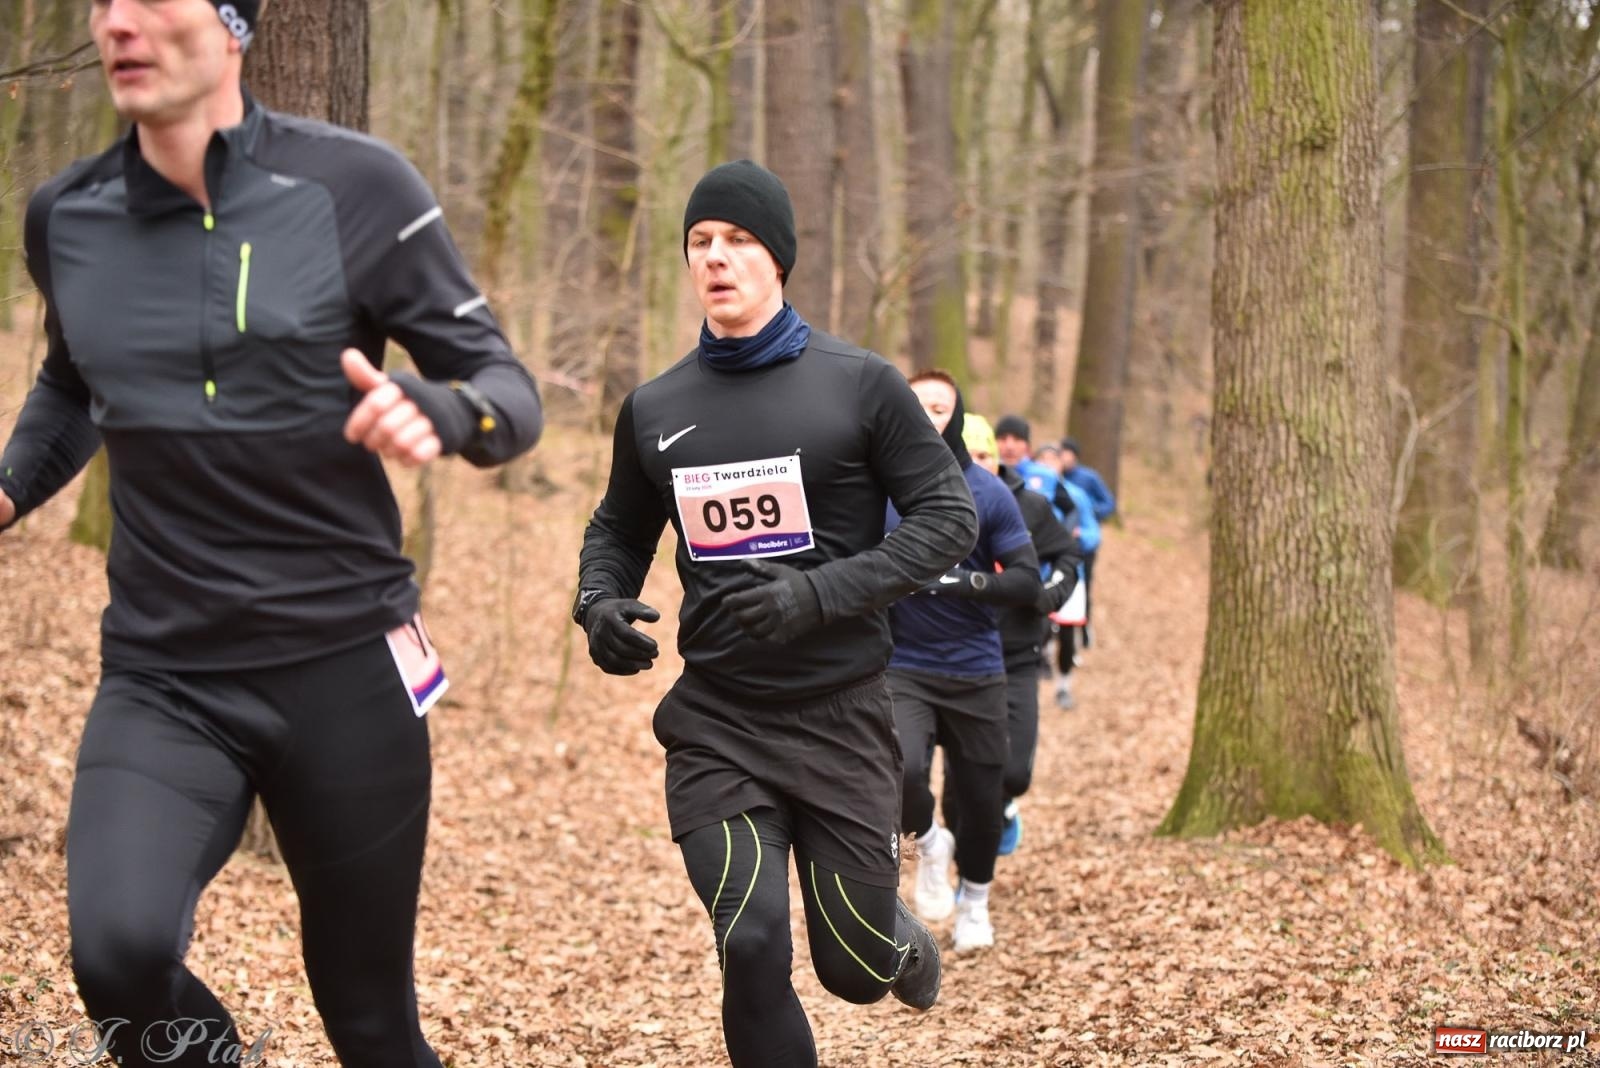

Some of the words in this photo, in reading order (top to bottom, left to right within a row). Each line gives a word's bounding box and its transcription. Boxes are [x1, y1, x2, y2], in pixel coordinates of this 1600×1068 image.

[684, 473, 711, 484] BIEG
[713, 465, 788, 481] Twardziela
[702, 494, 781, 533] 059
